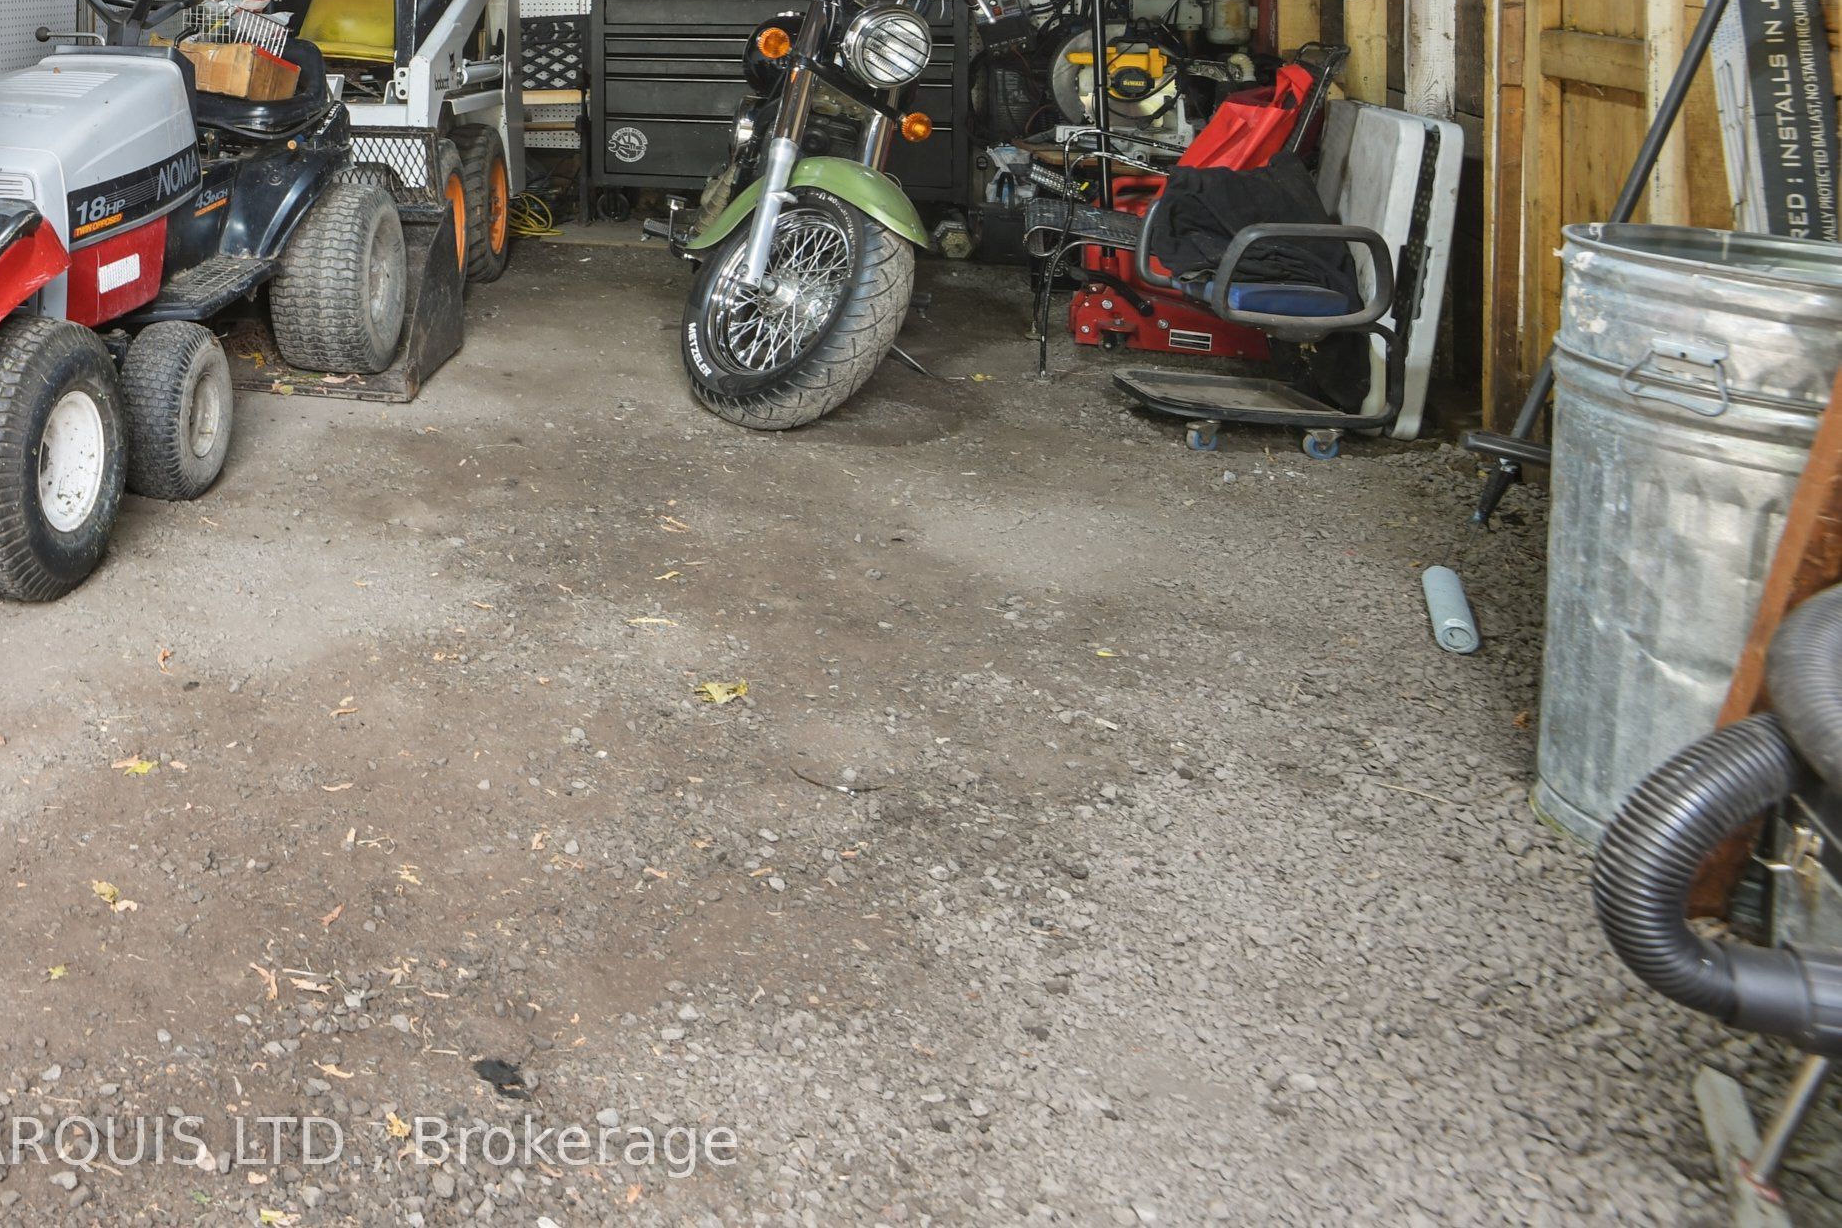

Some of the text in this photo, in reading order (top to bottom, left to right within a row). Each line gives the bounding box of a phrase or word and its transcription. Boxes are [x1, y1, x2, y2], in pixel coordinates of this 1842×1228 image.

[1763, 21, 1785, 43] IN
[1797, 38, 1817, 81] STARTER
[1768, 54, 1802, 167] INSTALLS
[1803, 83, 1819, 100] NO
[156, 149, 199, 201] NOMA
[1813, 149, 1834, 211] PROTECTED
[75, 214, 124, 237] TWIN OPPOSED
[688, 322, 713, 377] METZELER
